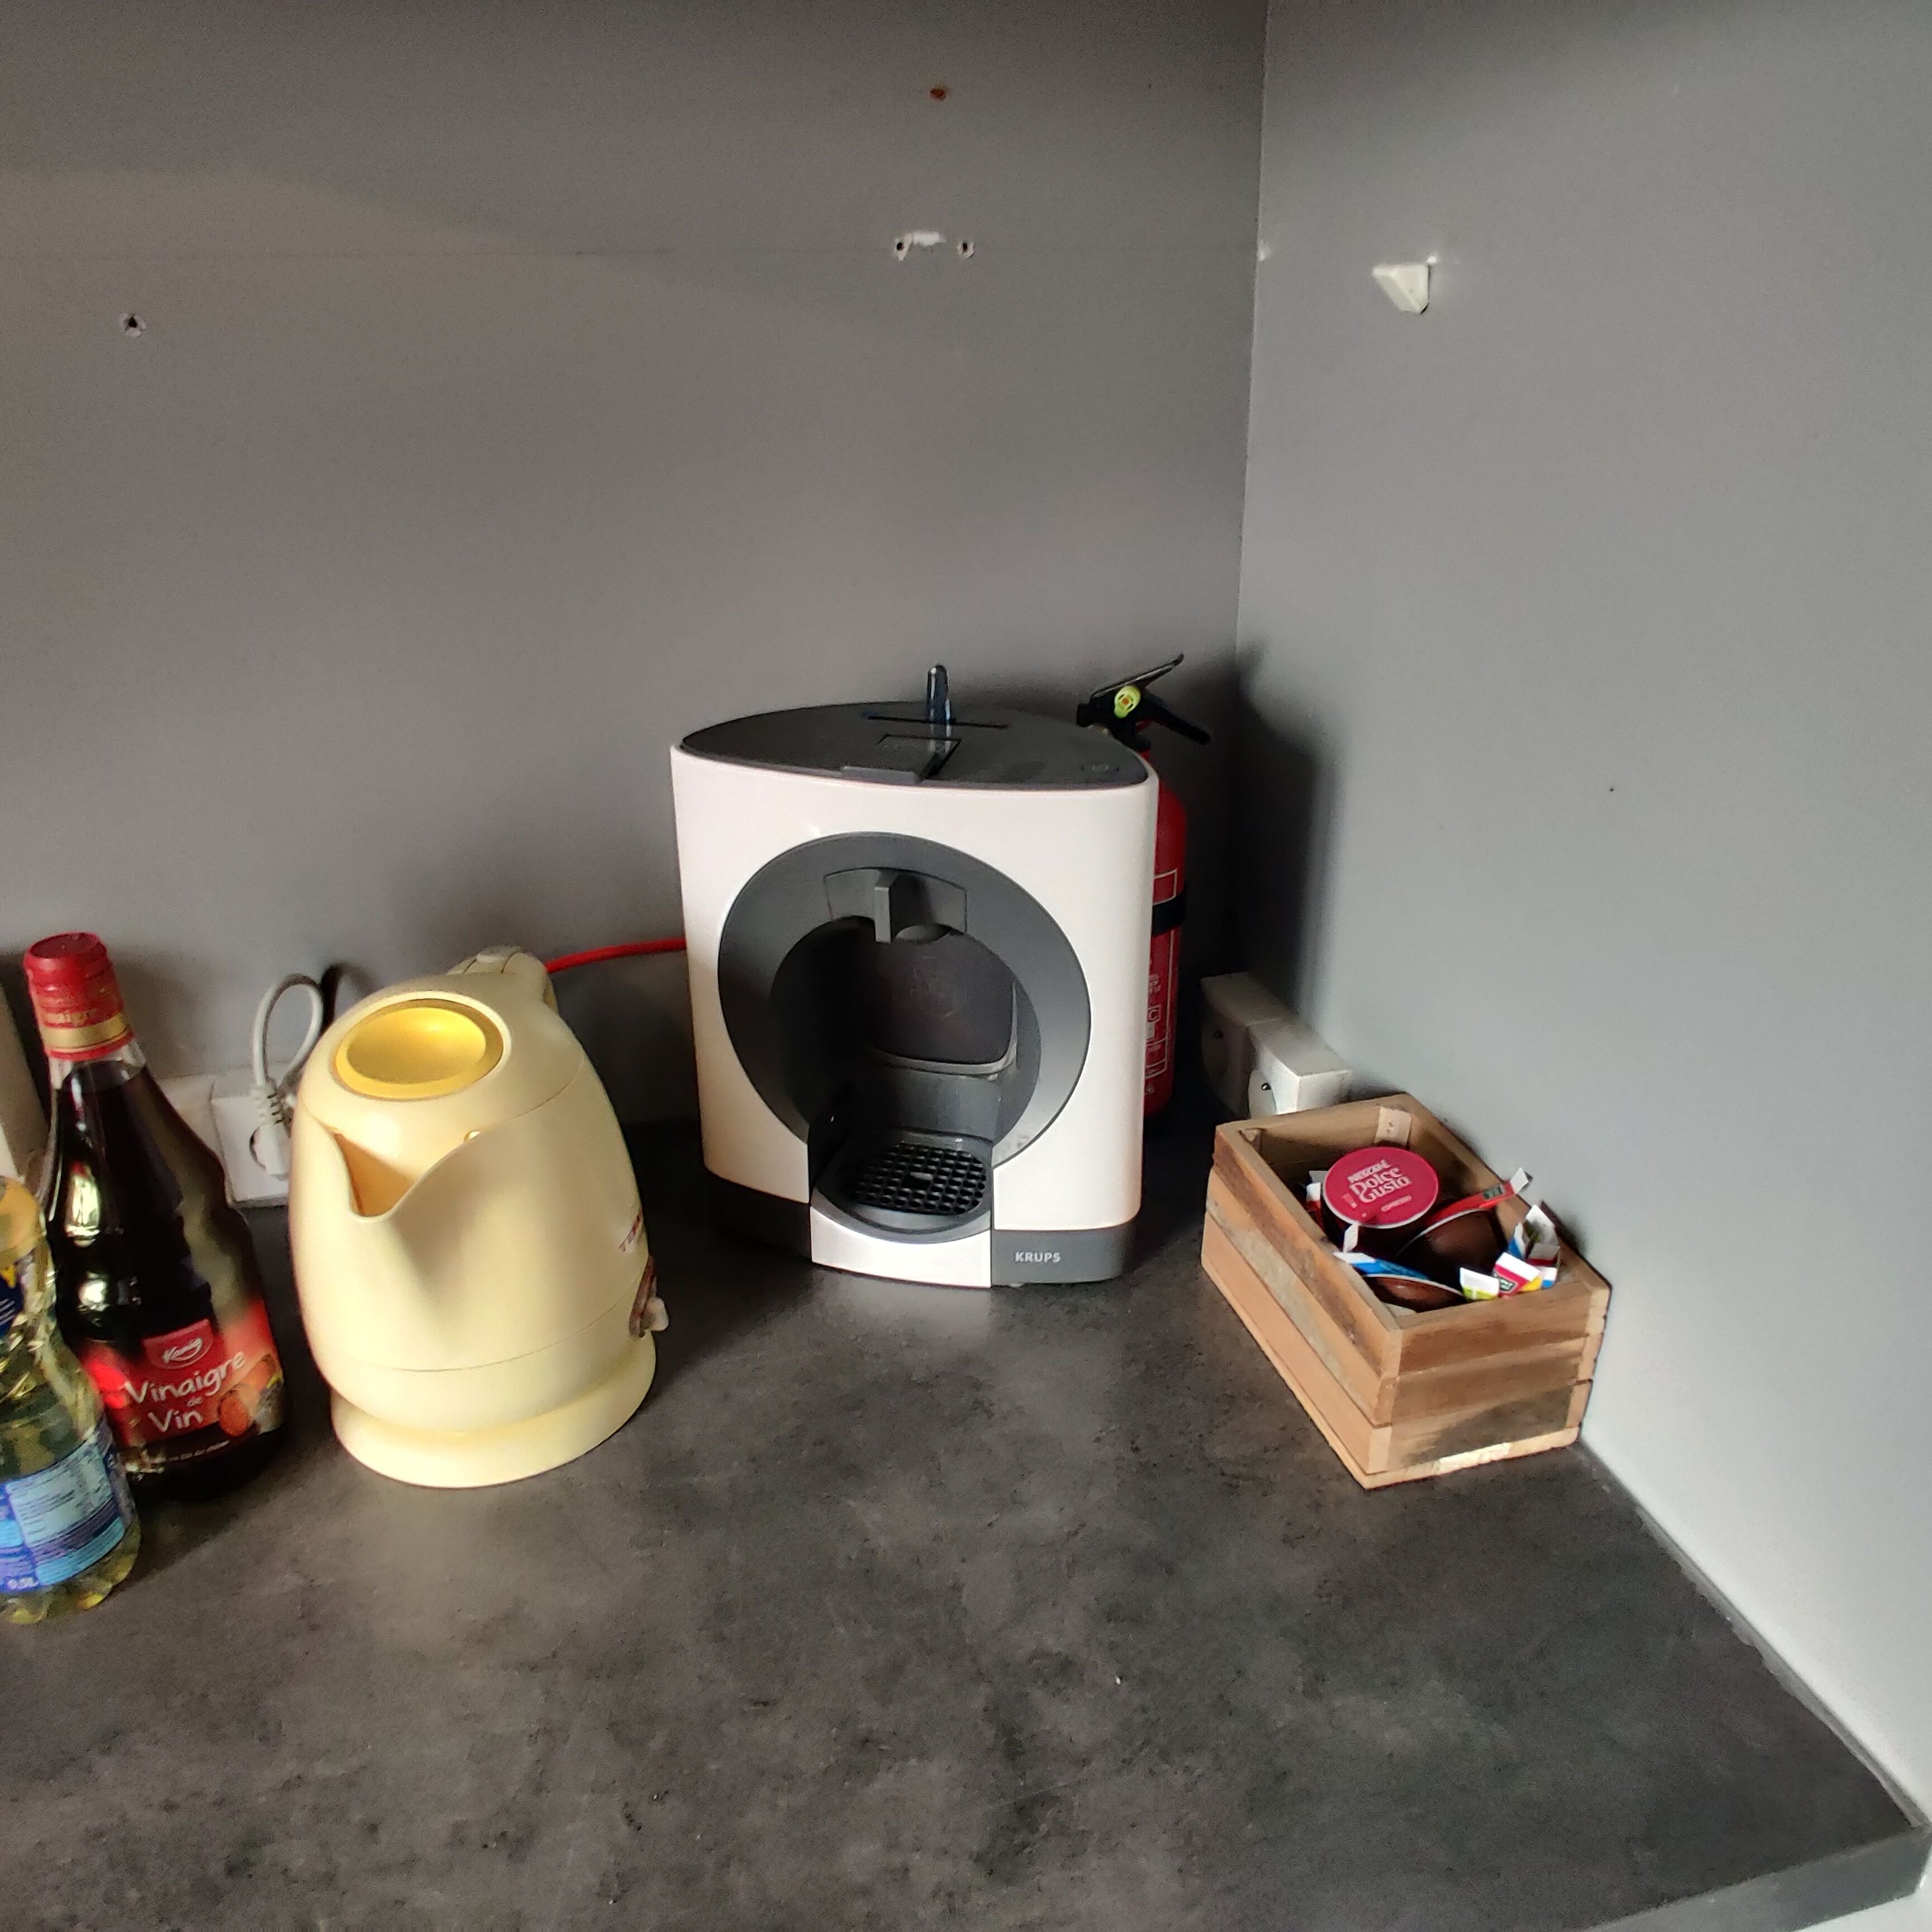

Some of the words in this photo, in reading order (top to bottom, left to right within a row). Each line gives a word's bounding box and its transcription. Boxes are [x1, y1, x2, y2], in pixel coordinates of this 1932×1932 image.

[1349, 1167, 1403, 1195] Dolce
[1359, 1176, 1412, 1202] Gusto
[1015, 1252, 1061, 1263] KRUPS
[124, 1351, 246, 1404] Vinaigre
[147, 1408, 203, 1433] Vin
